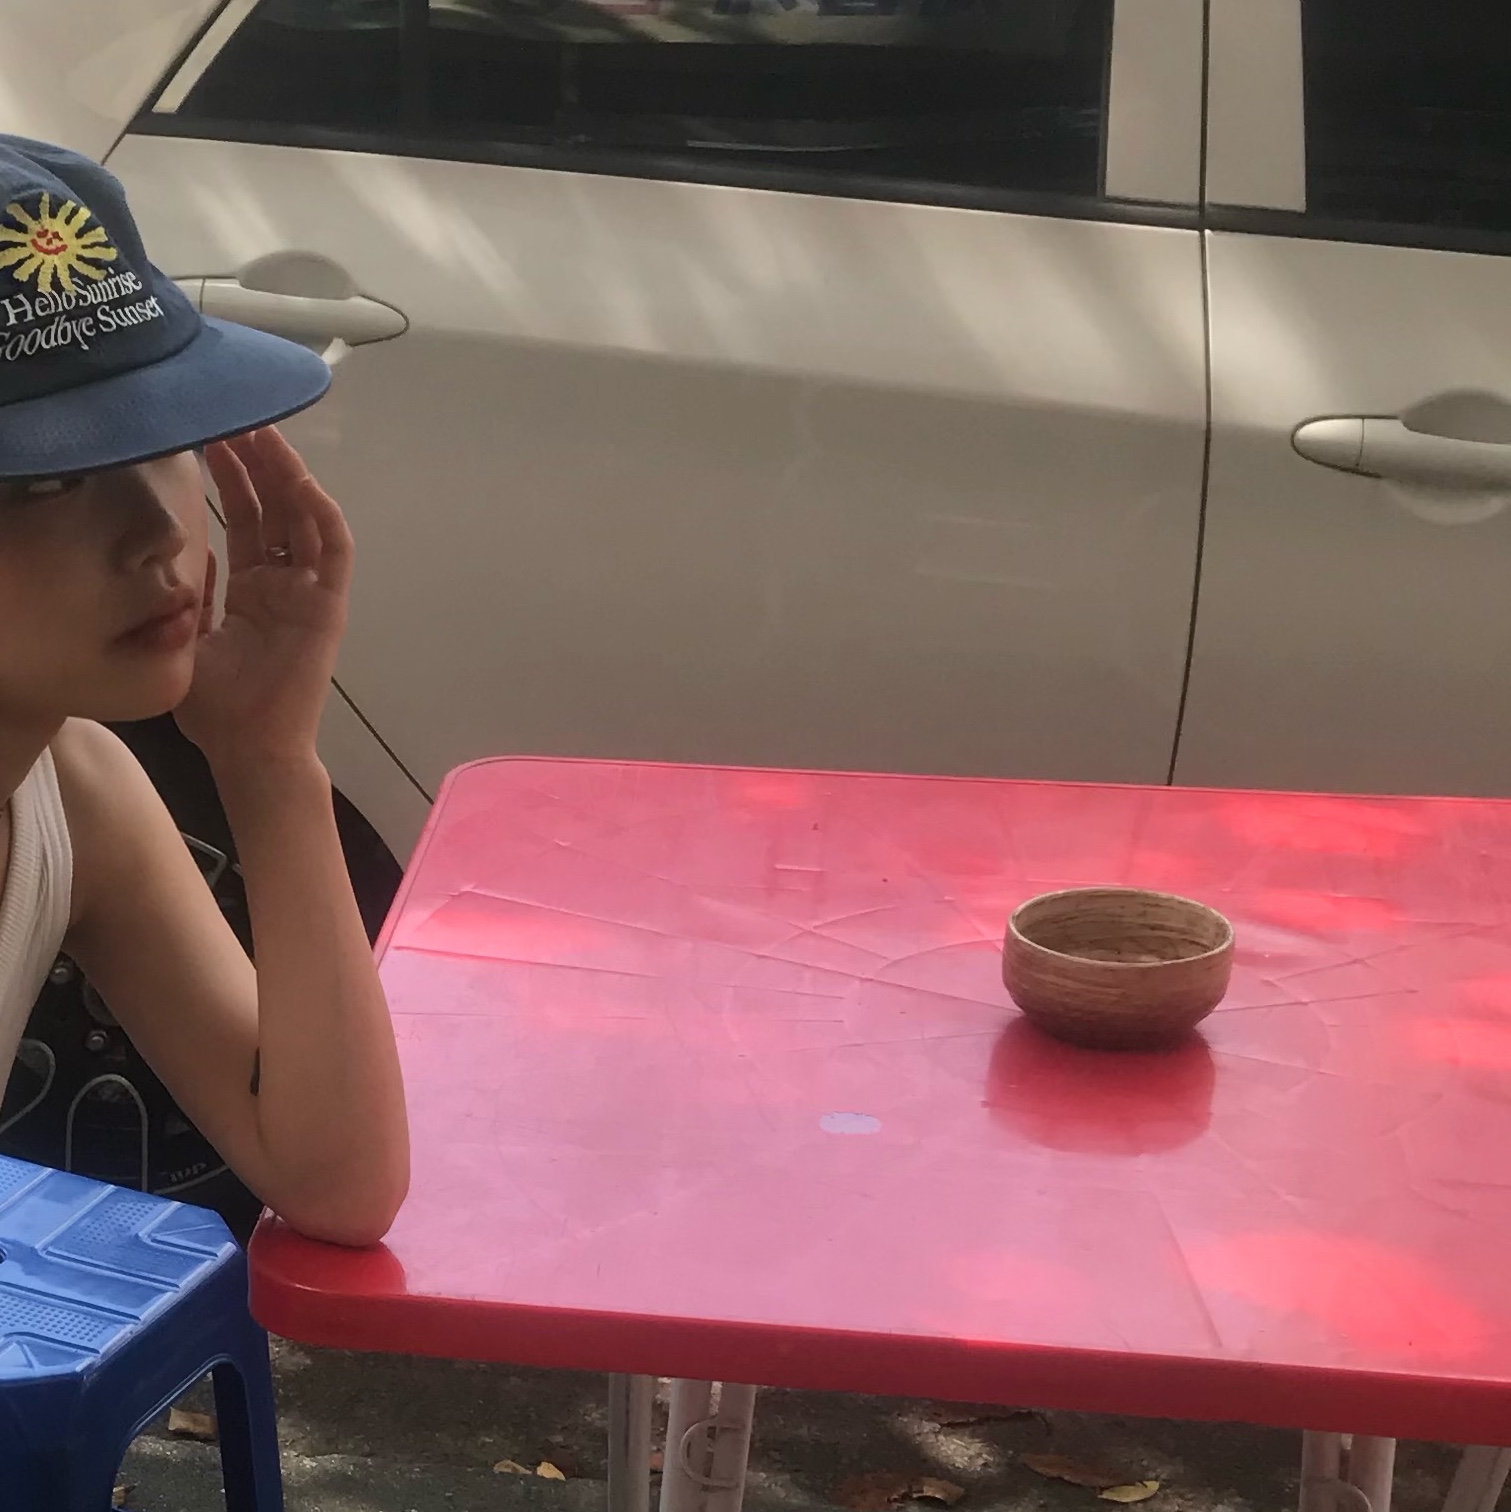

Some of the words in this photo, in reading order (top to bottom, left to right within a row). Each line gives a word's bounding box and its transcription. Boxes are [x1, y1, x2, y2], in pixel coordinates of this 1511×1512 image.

[0, 288, 76, 326] Hello
[72, 267, 142, 306] Sunrise
[97, 295, 164, 333] Sunset
